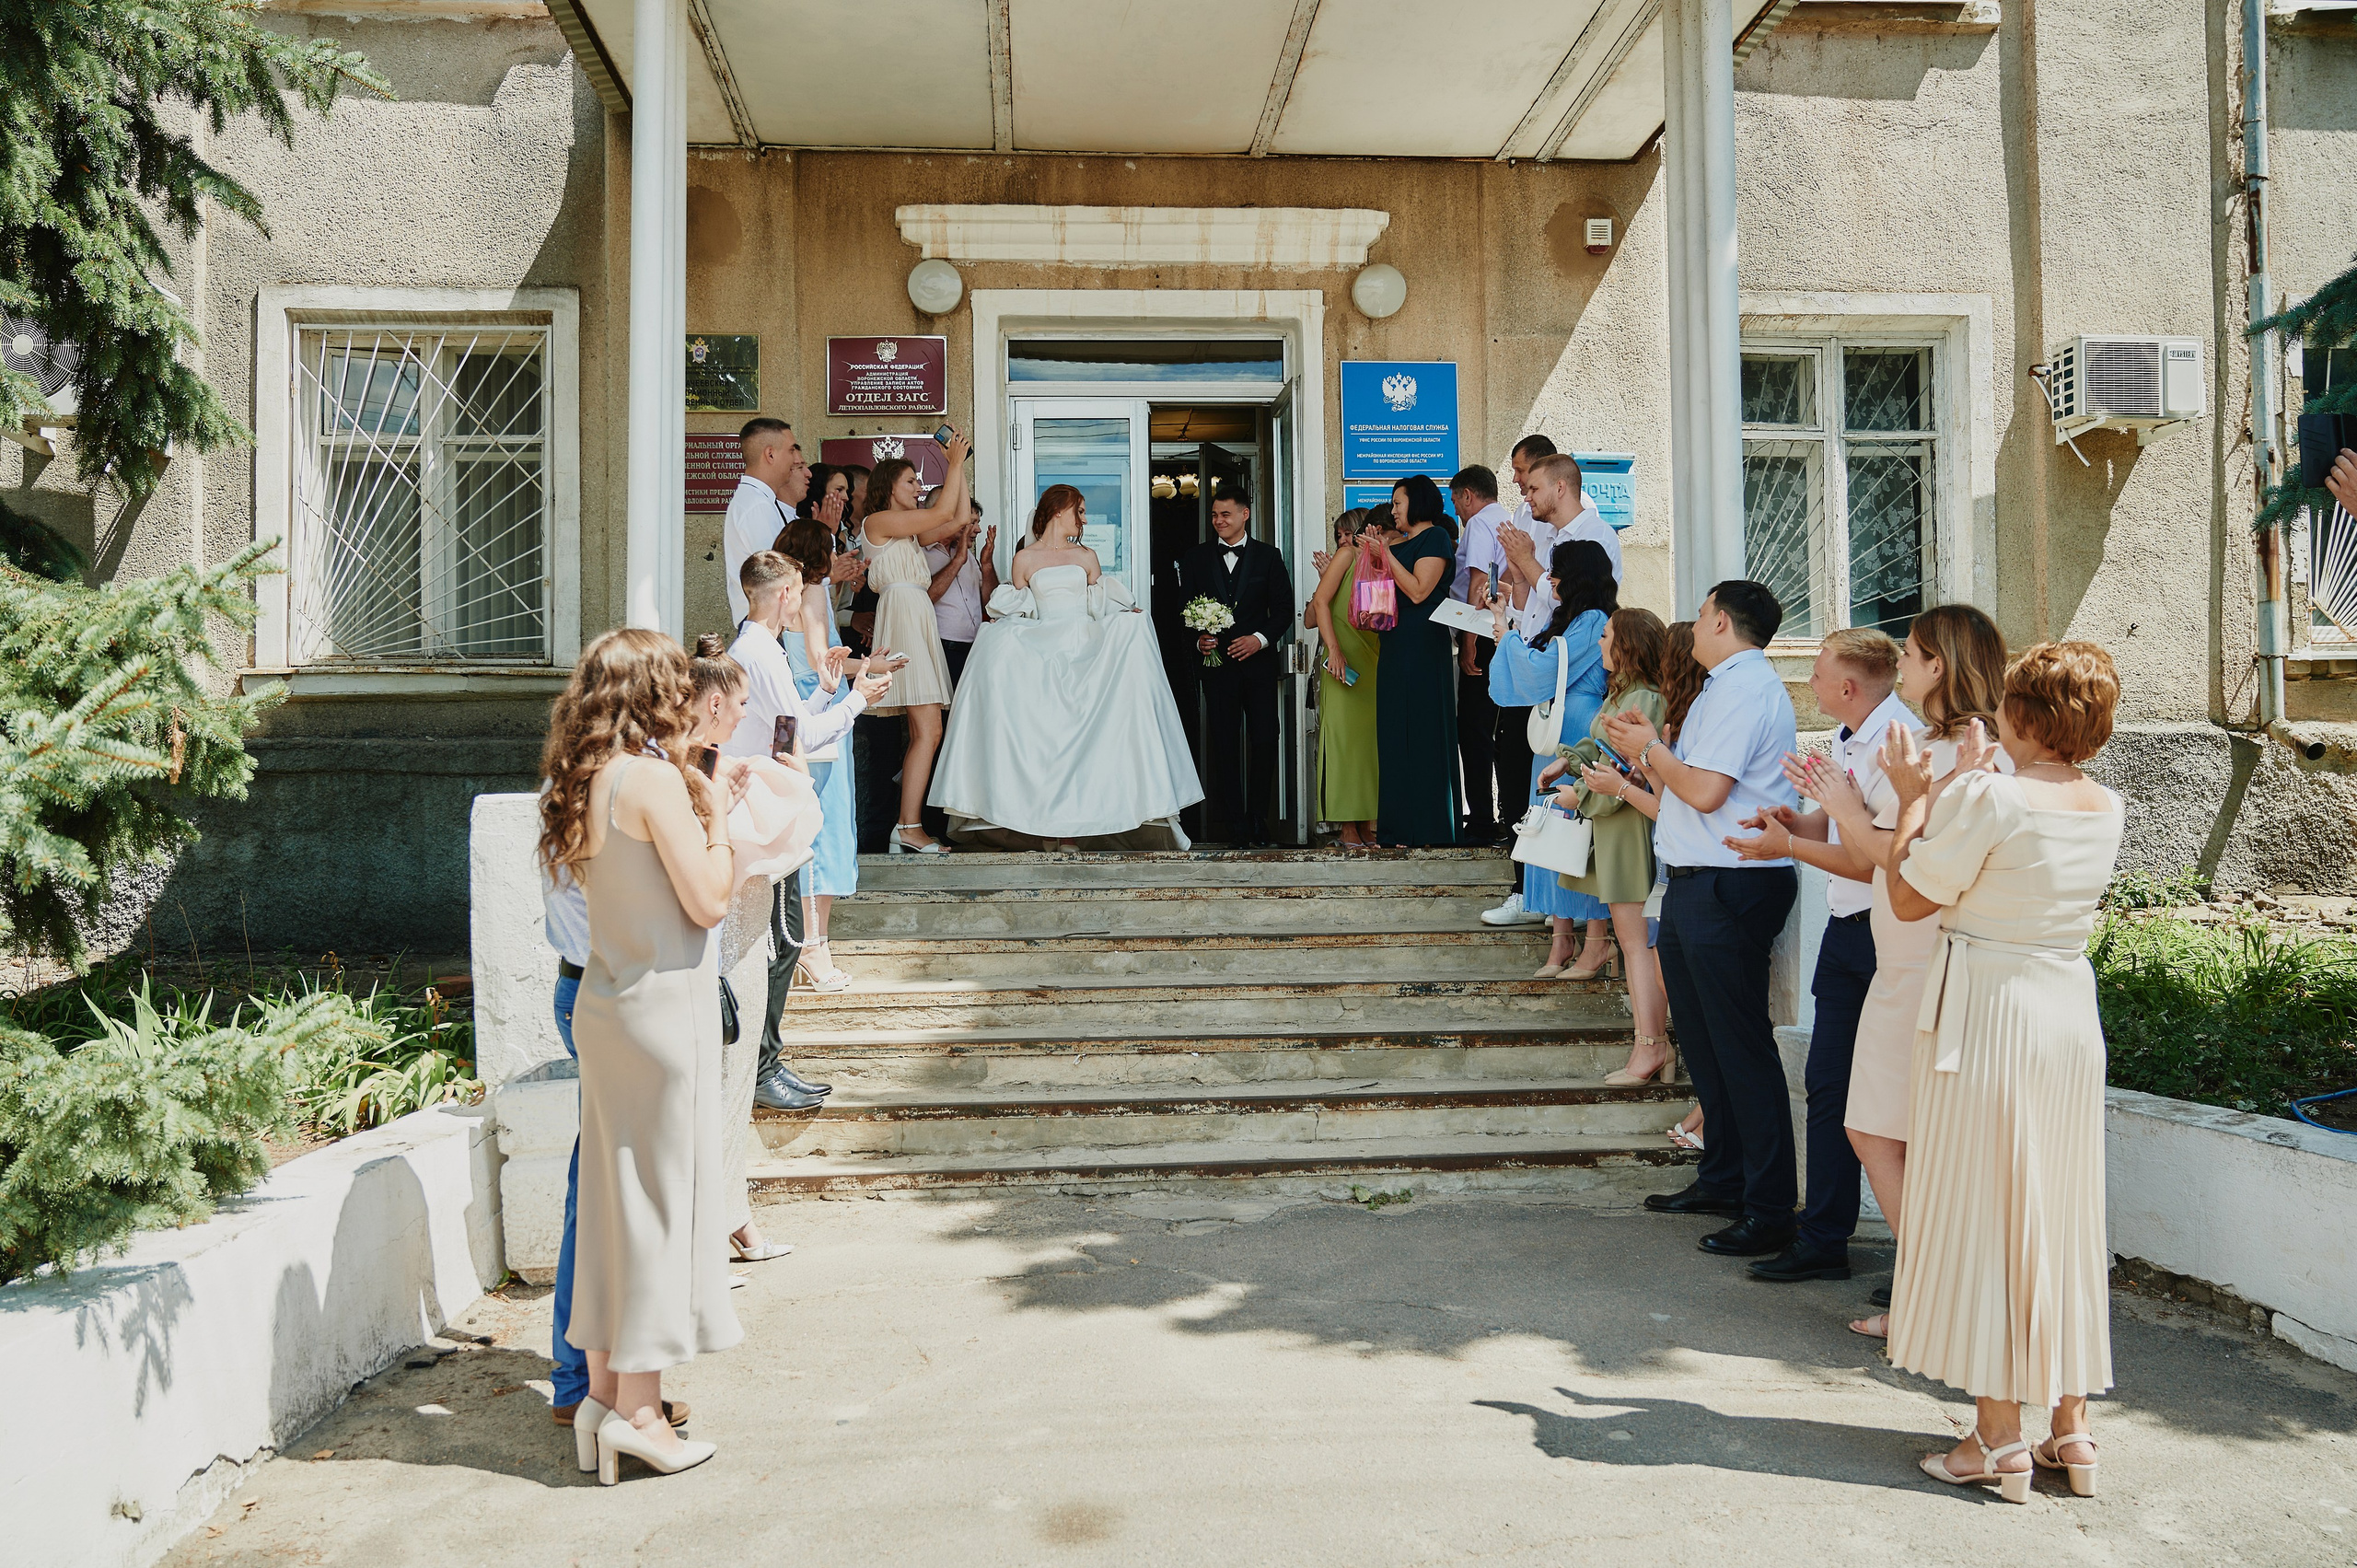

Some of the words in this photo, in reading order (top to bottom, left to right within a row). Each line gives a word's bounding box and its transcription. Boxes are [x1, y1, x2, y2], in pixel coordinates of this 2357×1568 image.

[719, 398, 745, 407] ОТДЕЛ
[845, 392, 892, 403] ОТДЕЛ
[895, 392, 929, 402] ЗАГС
